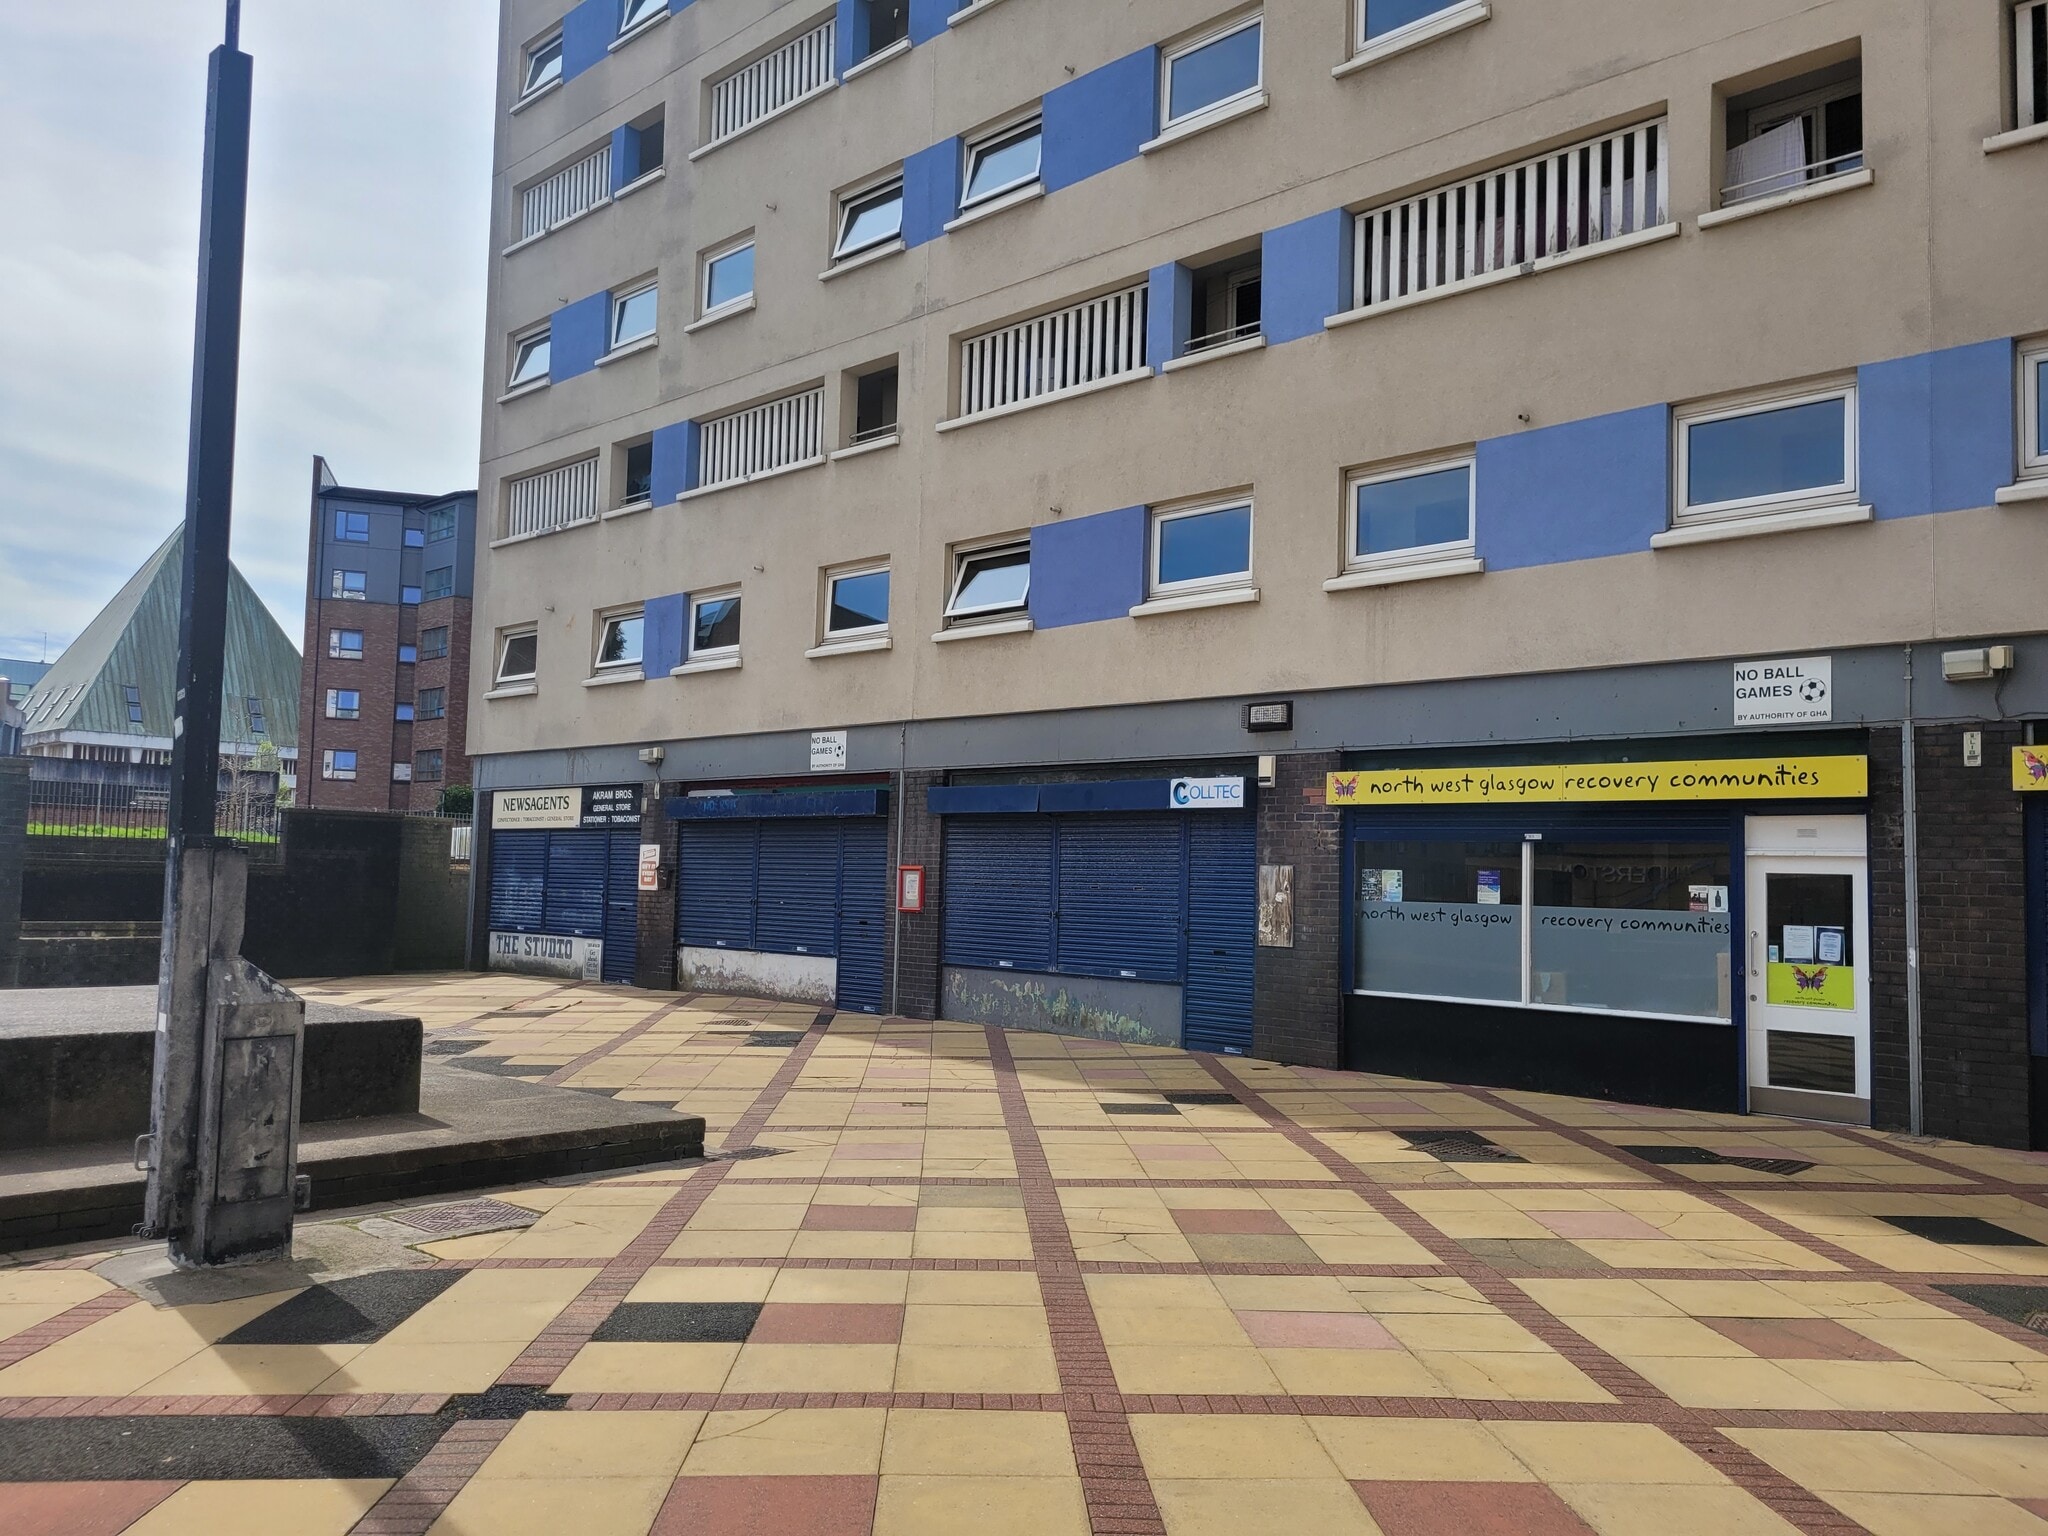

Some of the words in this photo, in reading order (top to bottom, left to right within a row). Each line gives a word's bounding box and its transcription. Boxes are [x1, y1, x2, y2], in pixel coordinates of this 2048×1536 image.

[1735, 669, 1758, 682] NO
[1764, 666, 1804, 680] BALL
[1736, 684, 1793, 699] GAMES
[1749, 712, 1794, 720] AUTHORITY
[811, 736, 821, 744] NO
[821, 735, 837, 744] BALL
[811, 746, 833, 755] GAMES
[1370, 775, 1424, 794] north
[1430, 773, 1474, 793] west
[1479, 773, 1555, 796] glasgow
[1564, 774, 1659, 793] recovery
[1669, 764, 1819, 787] communities
[592, 790, 613, 800] AKRAM
[615, 789, 634, 799] BROS.
[502, 795, 570, 812] NEWSAGENTS
[592, 804, 614, 812] GENERAL
[615, 803, 632, 811] STORE
[582, 816, 607, 824] STATIONER
[1361, 905, 1405, 922] north
[1410, 907, 1447, 922] west
[1450, 908, 1512, 927] glasgow
[1541, 916, 1613, 932] recovery
[1620, 916, 1730, 935] communities
[496, 934, 520, 955] THE
[524, 936, 573, 960] STUDIO
